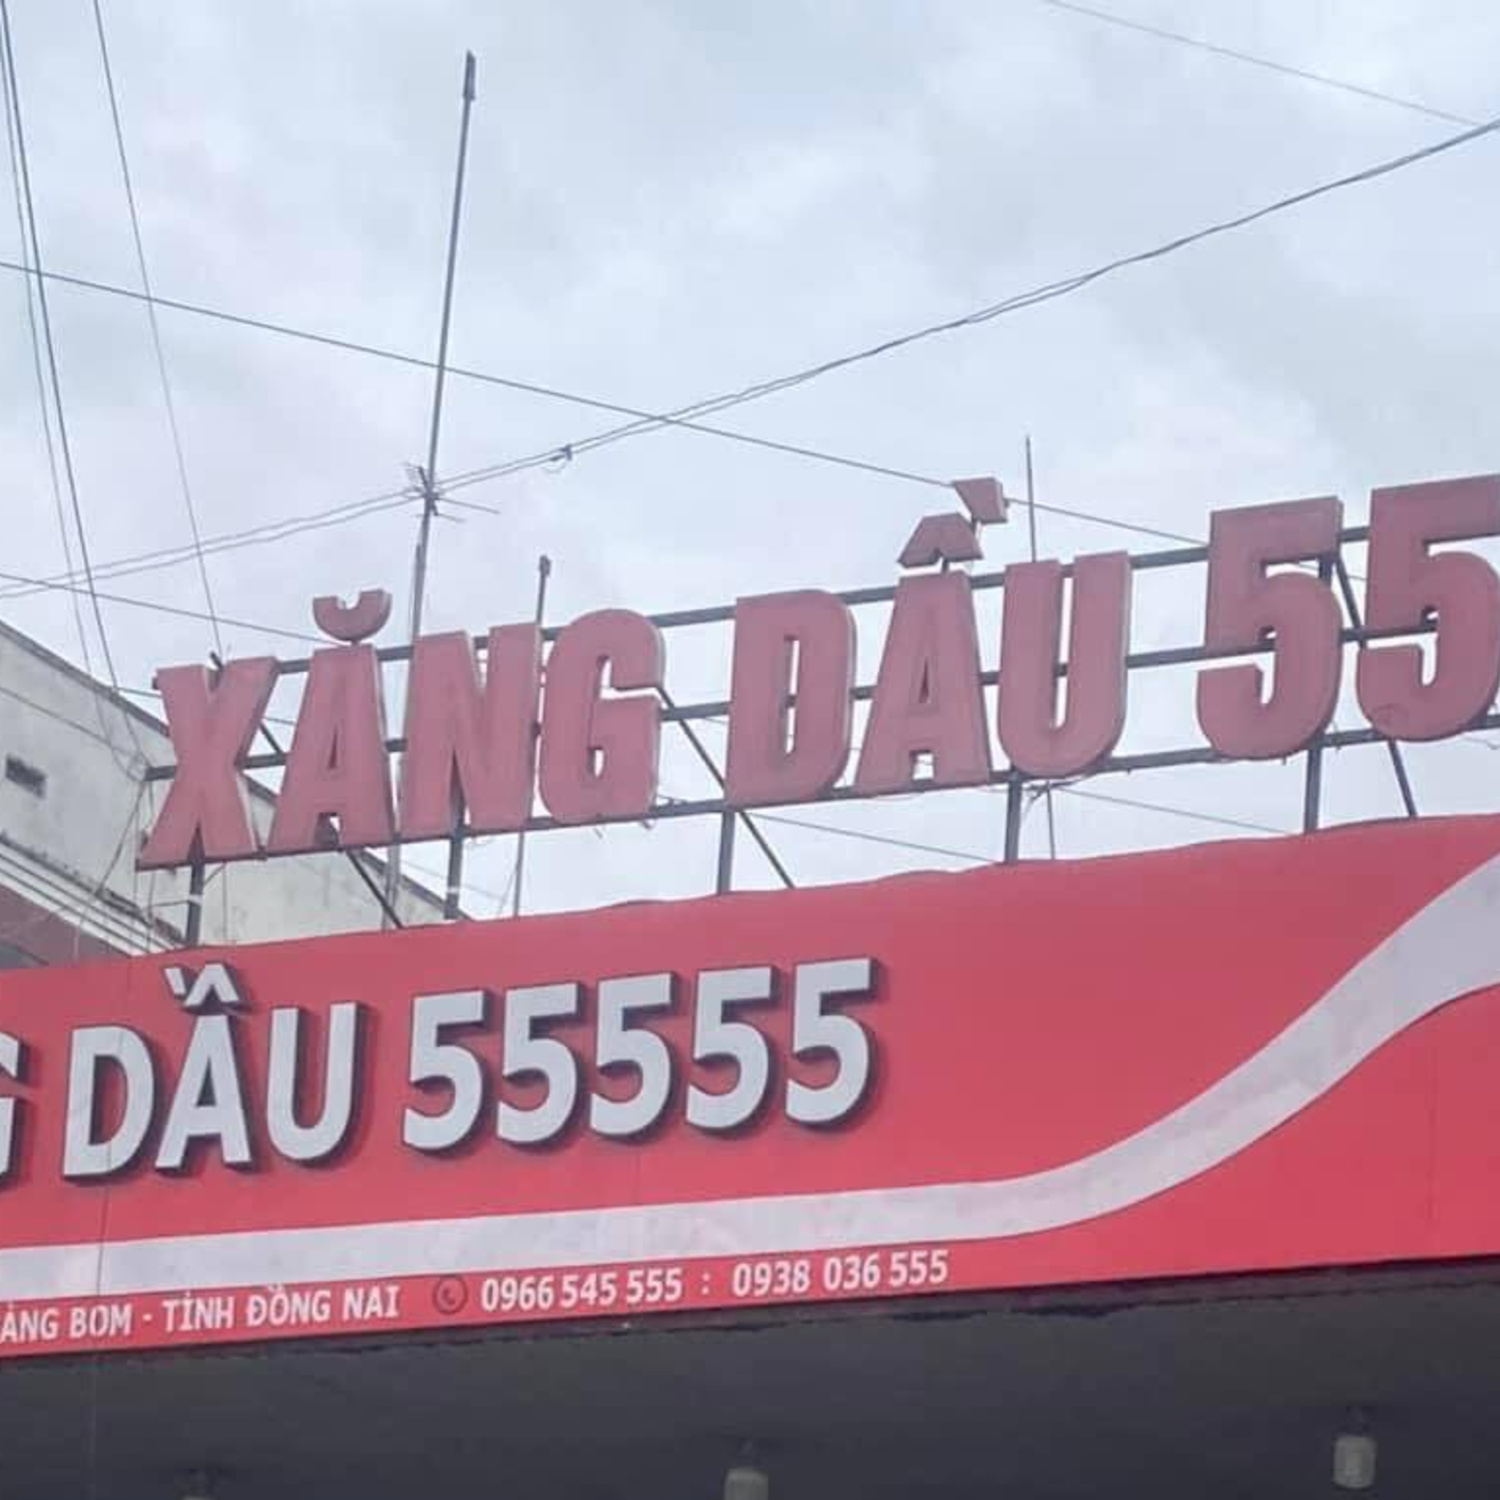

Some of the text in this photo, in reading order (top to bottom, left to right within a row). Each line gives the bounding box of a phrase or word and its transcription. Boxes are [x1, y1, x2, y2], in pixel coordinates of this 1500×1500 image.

[137, 587, 666, 870] XĂNG
[726, 477, 1128, 803] DẦU
[63, 964, 357, 1176] DẦU
[404, 958, 873, 1150] 55555
[69, 1304, 132, 1338] BOM
[246, 1282, 332, 1327] ĐỒNG
[341, 1284, 400, 1320] NAI
[481, 1275, 554, 1312] 0966
[561, 1271, 618, 1307] 545
[626, 1267, 682, 1305] 555
[732, 1259, 810, 1298] 0938
[823, 1254, 880, 1292] 036
[888, 1249, 949, 1287] 555
